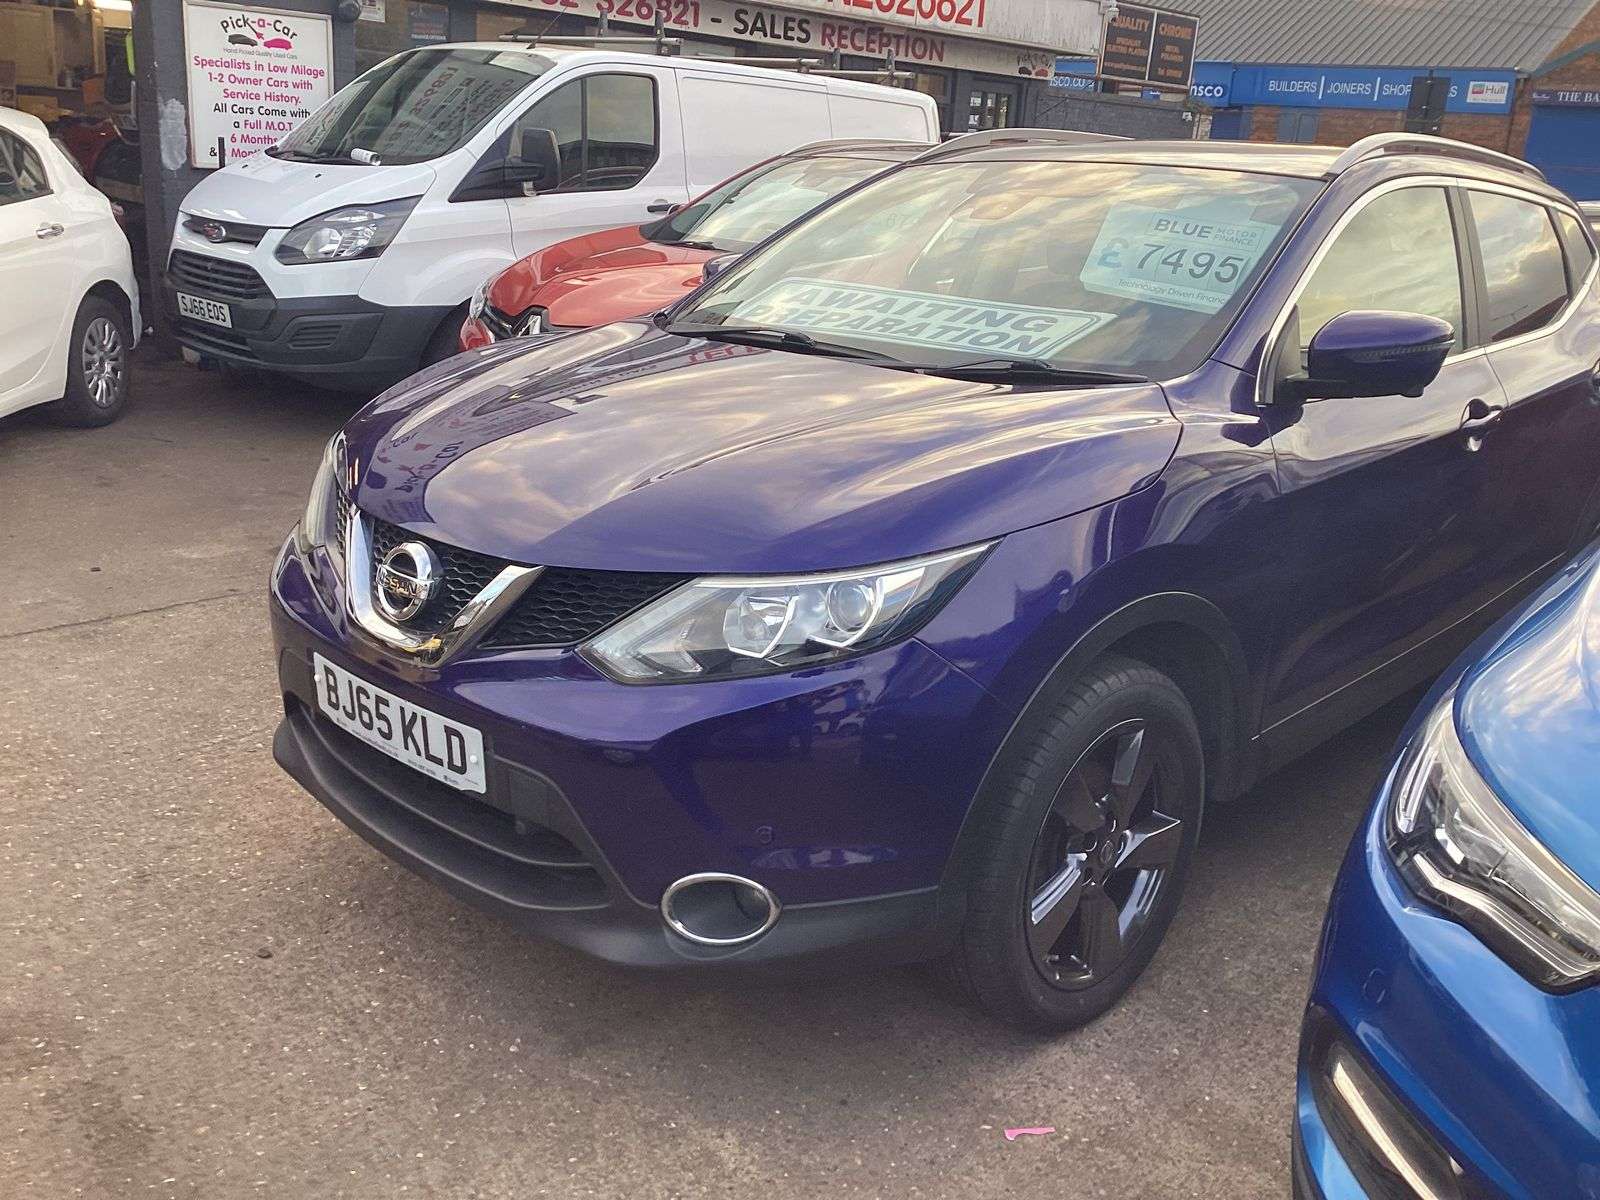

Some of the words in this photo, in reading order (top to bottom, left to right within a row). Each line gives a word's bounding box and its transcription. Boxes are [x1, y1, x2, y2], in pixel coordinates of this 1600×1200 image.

[733, 8, 811, 44] SALES
[820, 22, 946, 63] RECEPTION
[193, 56, 251, 71] Specialists
[254, 61, 264, 71] in
[267, 62, 288, 74] Low
[290, 64, 325, 79] Milage
[208, 72, 225, 83] 1-2
[228, 73, 263, 86] Owner
[266, 77, 289, 89] Cars
[292, 80, 313, 90] with
[1268, 80, 1318, 93] BUILDERS
[1327, 82, 1372, 95] JOINERS
[223, 88, 260, 101] Service
[264, 91, 302, 105] History.
[1557, 91, 1581, 102] THE
[213, 103, 227, 113] All
[231, 104, 254, 115] Cars
[257, 105, 287, 117] Come
[290, 108, 311, 119] with
[233, 121, 240, 129] a
[244, 119, 262, 130] Full
[230, 133, 237, 143] 6
[209, 147, 218, 157] &
[1153, 218, 1214, 239] BLUE
[1136, 243, 1245, 284] 7495
[180, 295, 206, 317] SJ66
[784, 288, 1059, 333] AWAITING
[747, 303, 1050, 353] PREPARATION
[323, 663, 393, 741] BJ65
[399, 705, 468, 776] KLD
